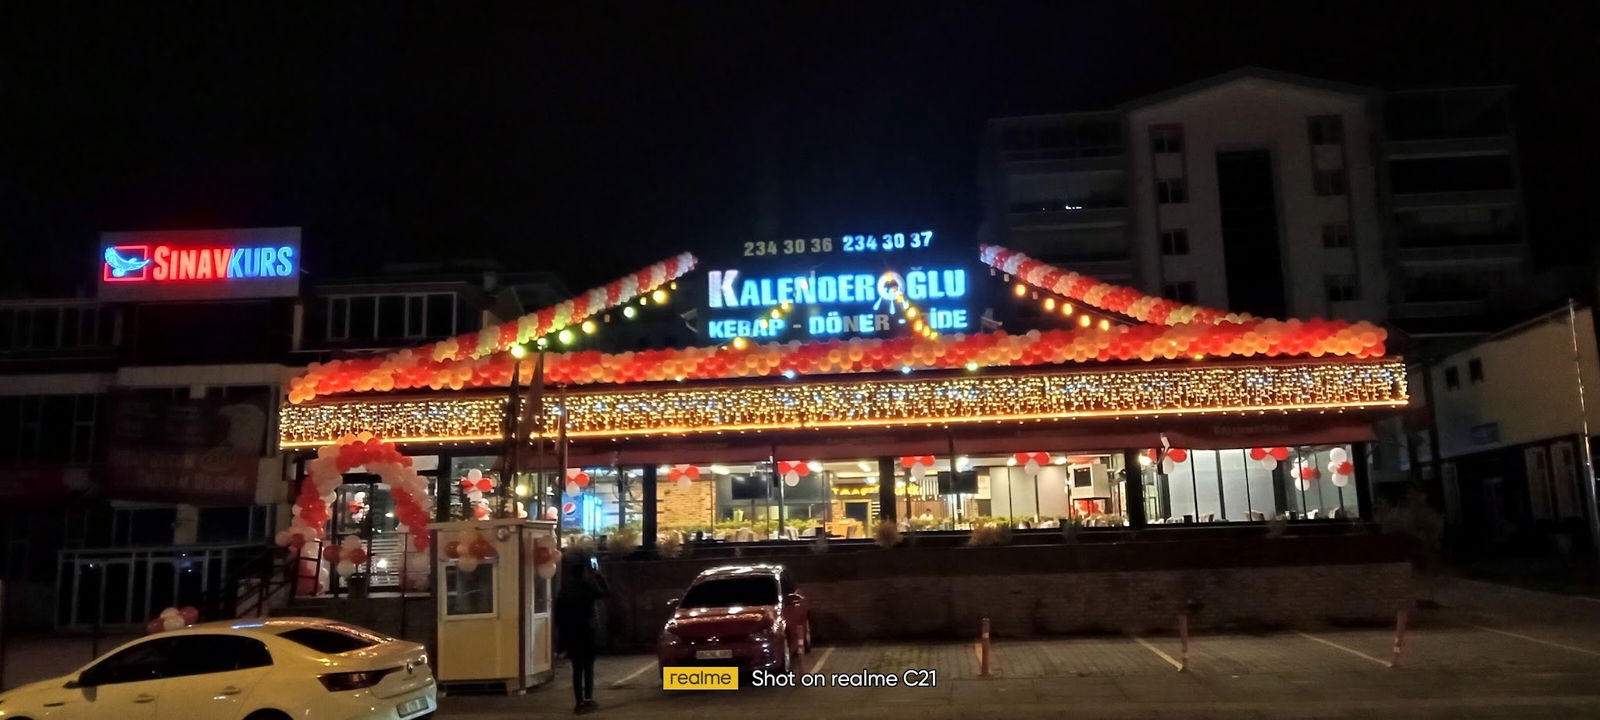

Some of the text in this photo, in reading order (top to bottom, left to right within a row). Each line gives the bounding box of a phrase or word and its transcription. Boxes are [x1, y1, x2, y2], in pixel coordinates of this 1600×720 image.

[744, 231, 933, 257] 234 30 36 234 30 37
[708, 265, 966, 309] KALENDEROĞLU
[708, 317, 785, 338] KEBAP
[809, 311, 890, 335] DÖNER
